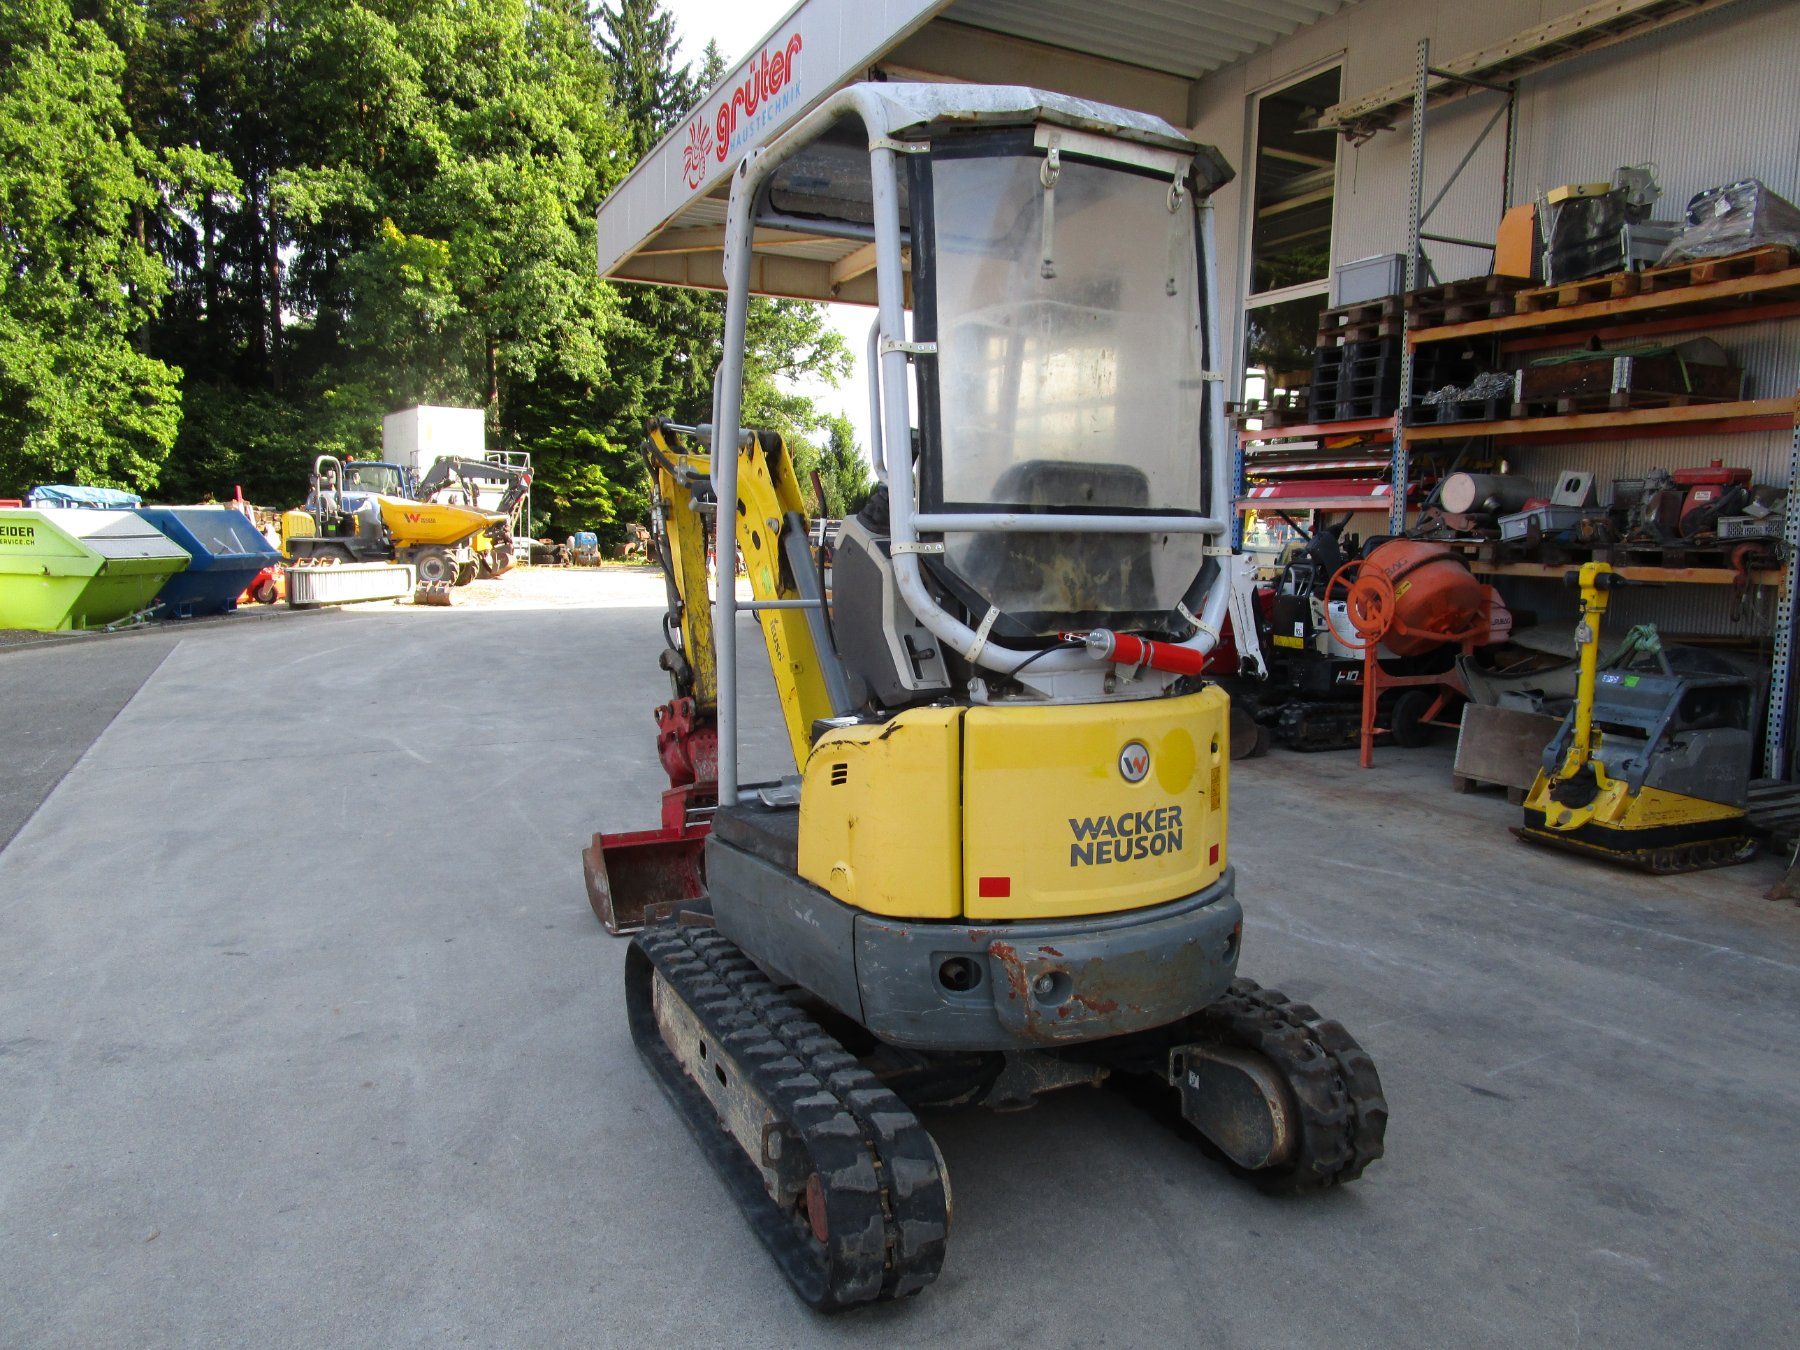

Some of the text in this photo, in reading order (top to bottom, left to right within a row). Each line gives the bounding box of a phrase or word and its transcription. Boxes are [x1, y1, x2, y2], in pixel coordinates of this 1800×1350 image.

[716, 33, 802, 162] grüter
[1068, 805, 1183, 841] WACKER
[1070, 828, 1183, 867] NEUSON
